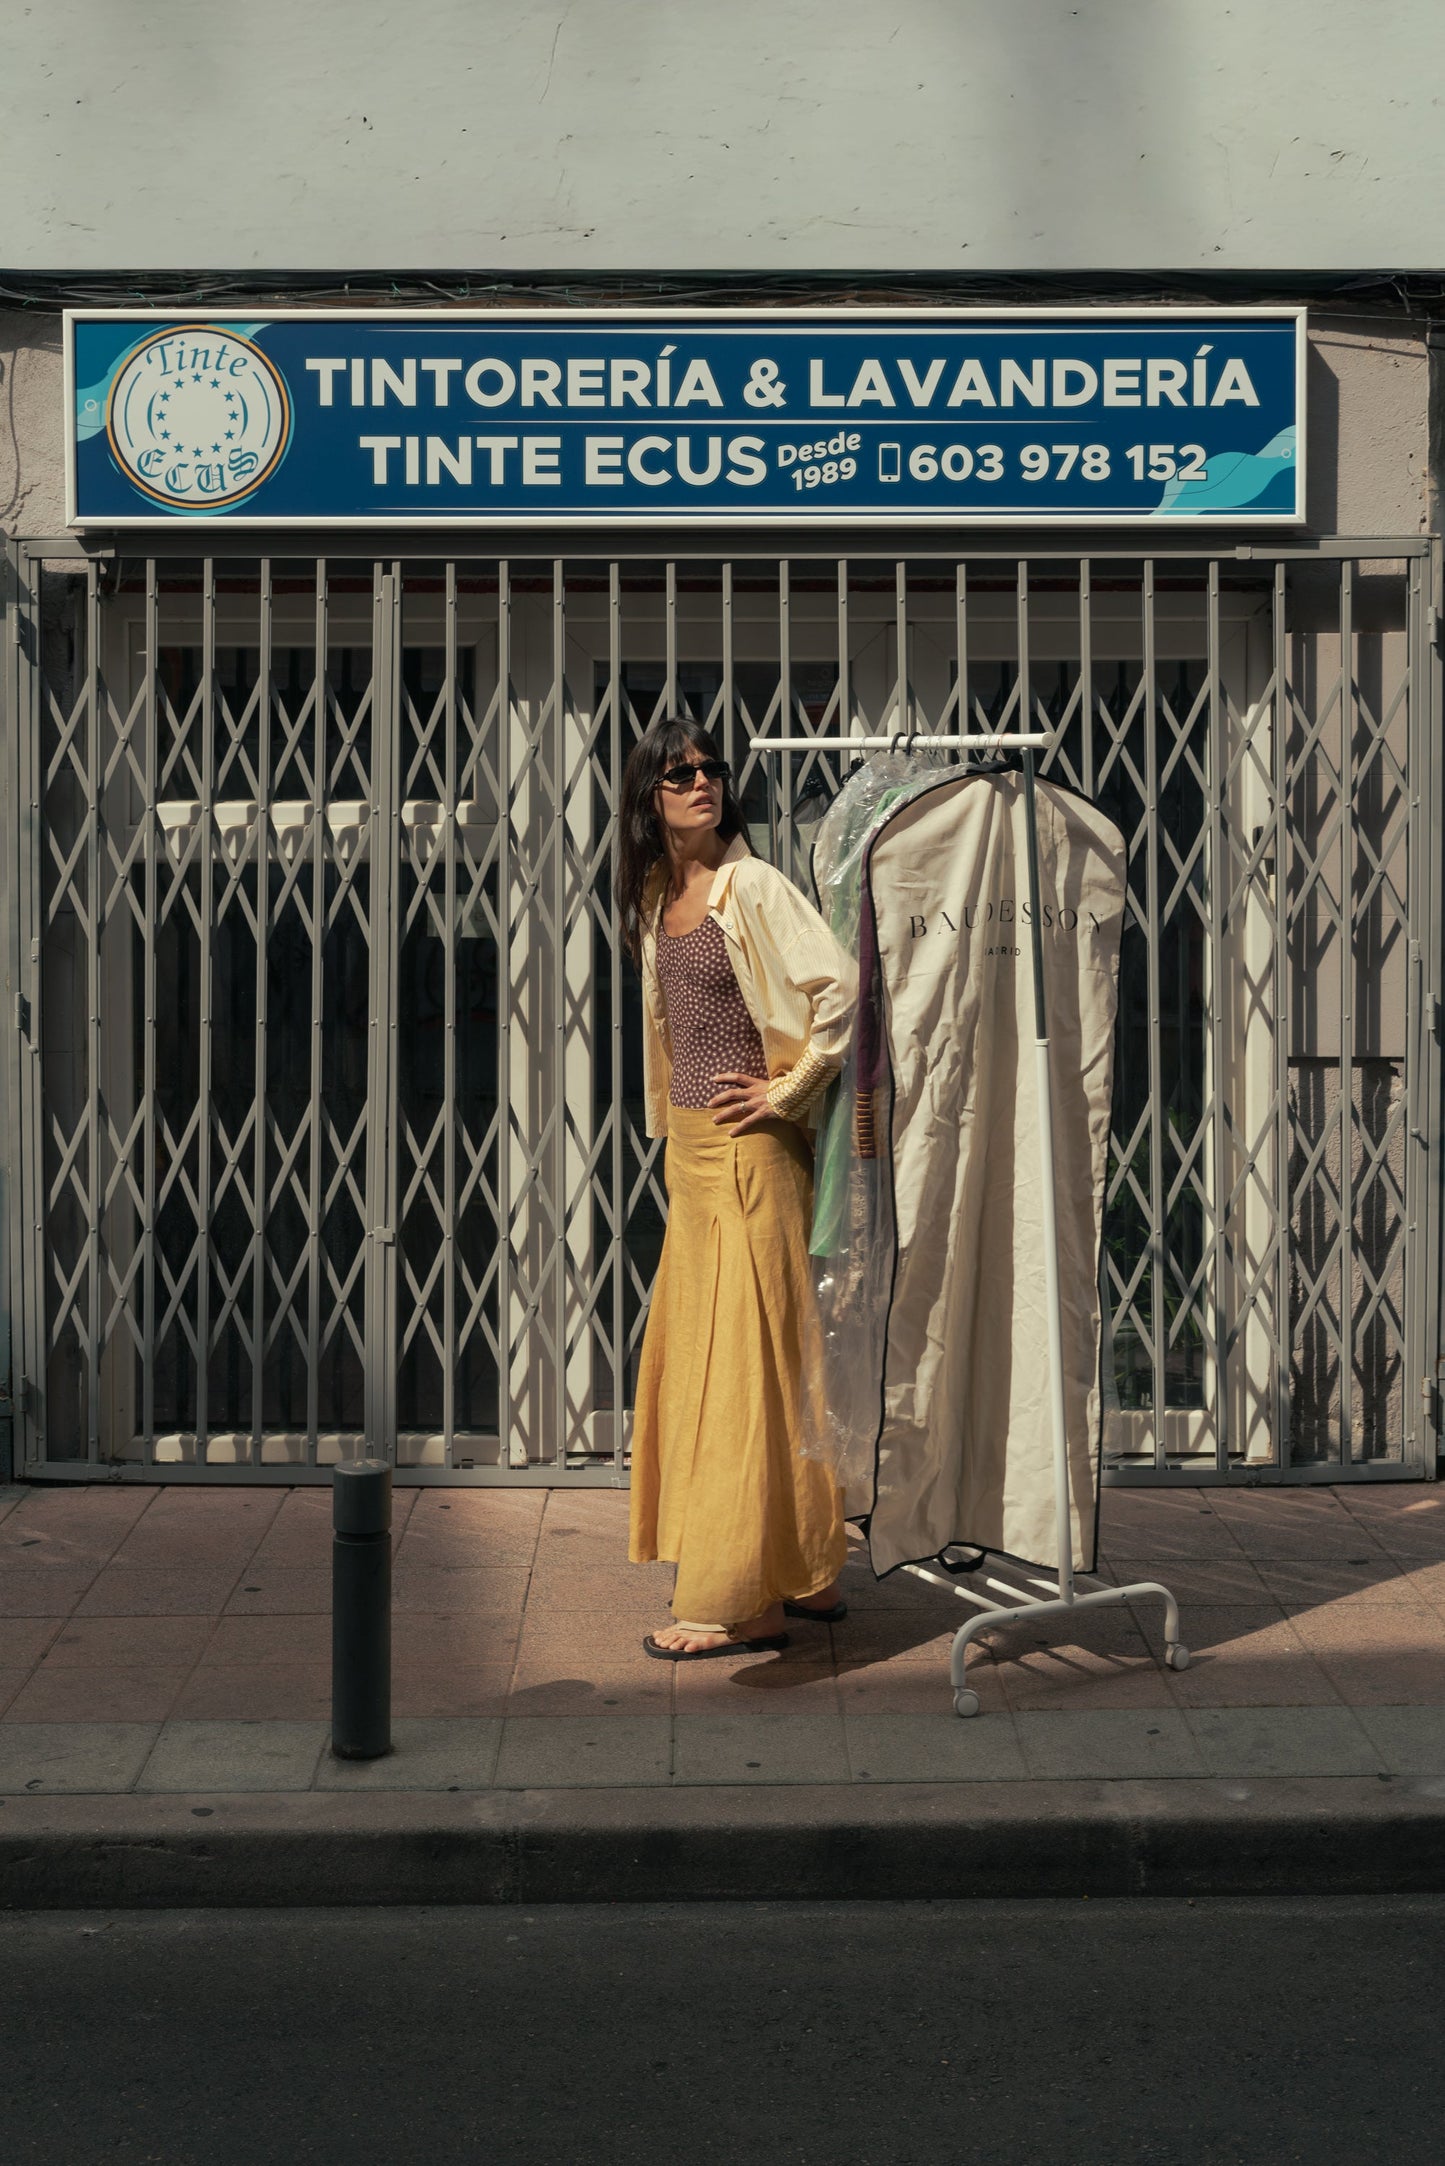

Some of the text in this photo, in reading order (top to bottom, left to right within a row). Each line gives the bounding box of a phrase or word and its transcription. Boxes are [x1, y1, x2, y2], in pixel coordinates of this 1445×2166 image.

[146, 339, 248, 377] Tinte
[305, 345, 1261, 408] TINTORERÍA & LAVANDERÍA
[360, 436, 767, 486] TINTE ECUS
[778, 431, 861, 467] Desde
[909, 444, 1208, 482] 603 978 152
[136, 445, 259, 494] ECUS
[791, 457, 857, 491] 1989
